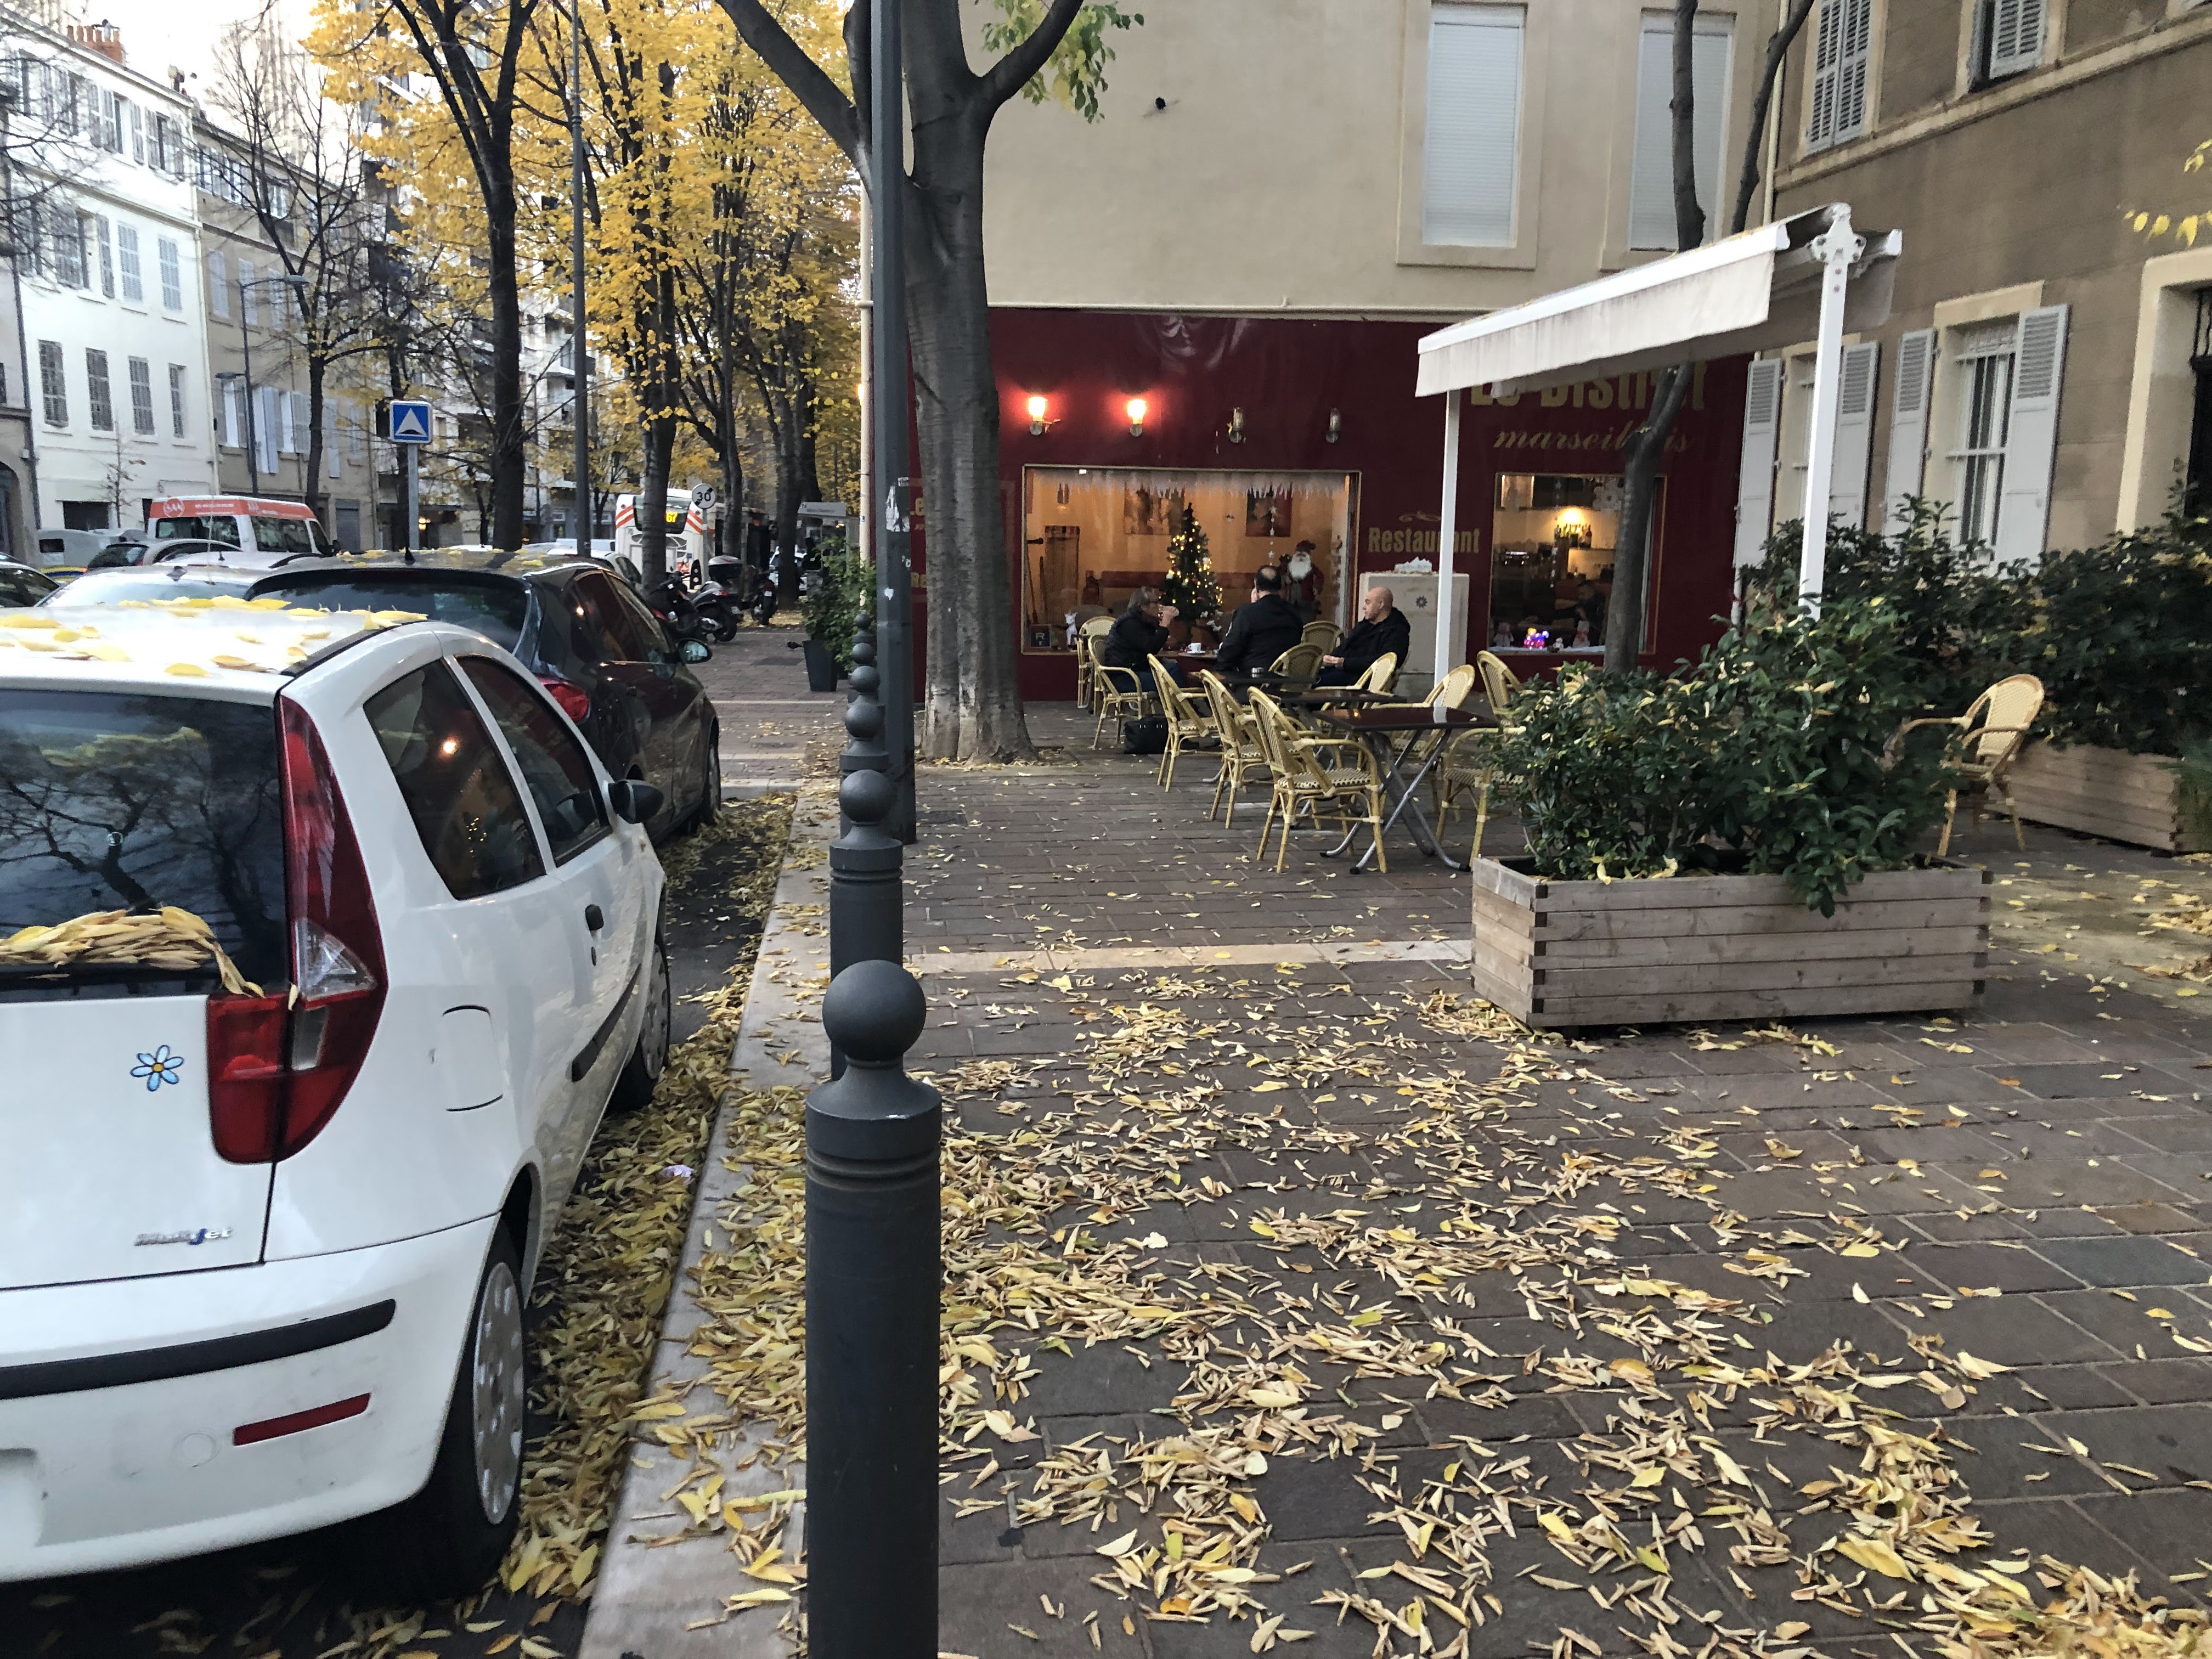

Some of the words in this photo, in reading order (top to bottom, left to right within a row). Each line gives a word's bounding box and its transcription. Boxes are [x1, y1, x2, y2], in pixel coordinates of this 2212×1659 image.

[1493, 420, 1687, 452] marseilis
[696, 492, 712, 502] 30
[665, 511, 678, 523] 67
[1368, 527, 1480, 553] Restaunt
